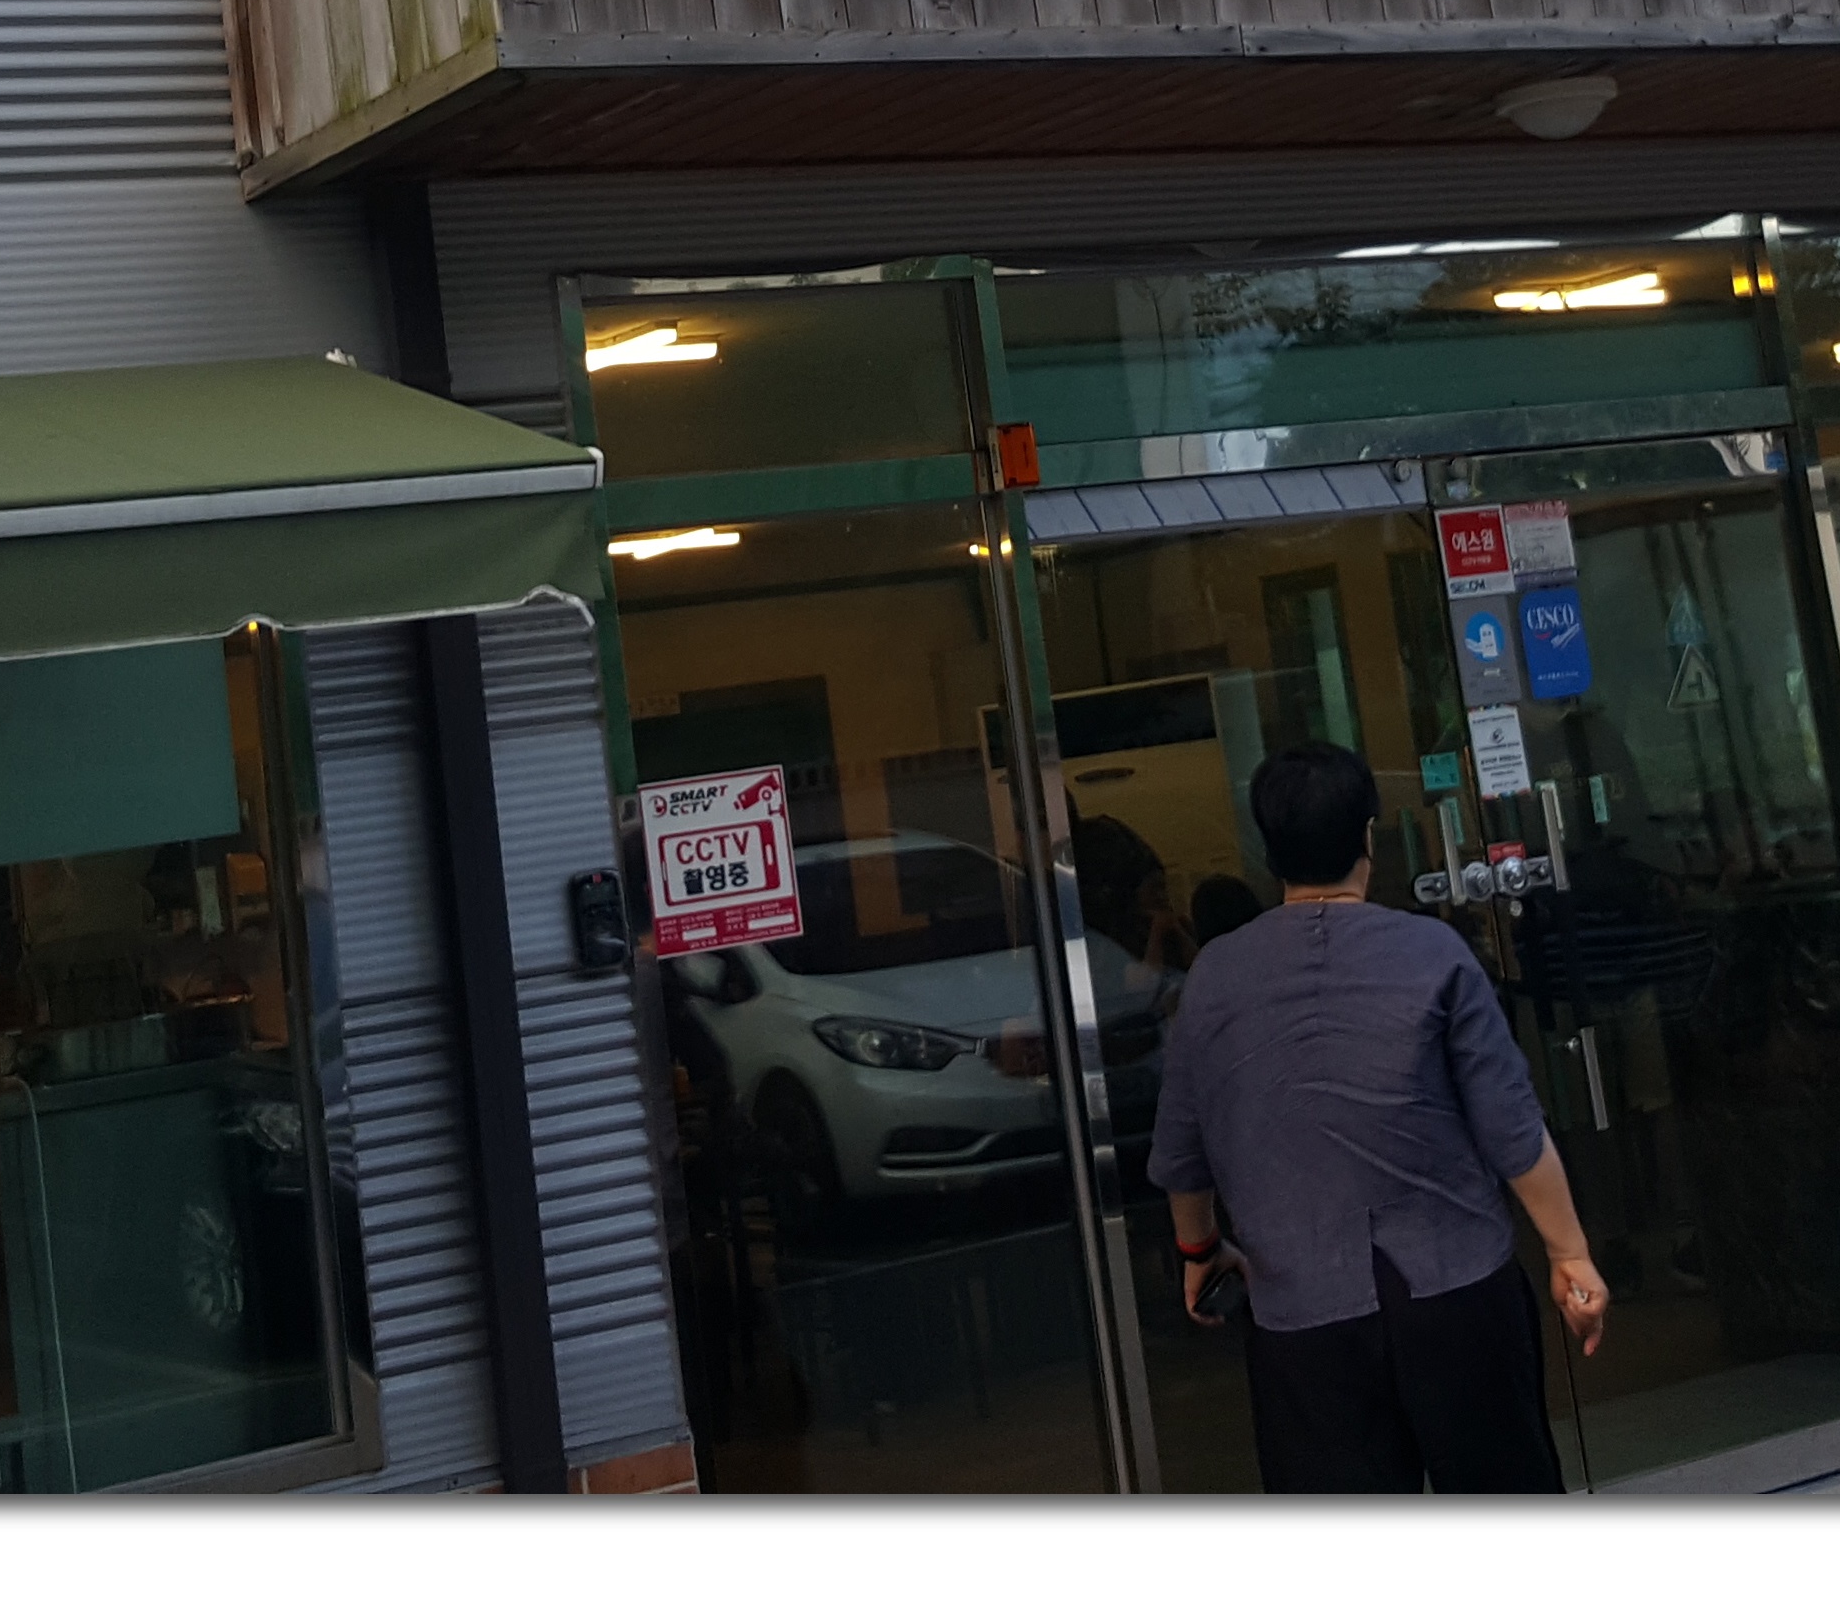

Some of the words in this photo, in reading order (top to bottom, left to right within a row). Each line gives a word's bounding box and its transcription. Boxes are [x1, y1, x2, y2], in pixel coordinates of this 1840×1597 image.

[1527, 603, 1575, 631] CESCO
[669, 784, 728, 804] SMART
[669, 800, 713, 817] CCTV
[676, 831, 751, 865] CCTV
[683, 861, 750, 896] 촬영중
